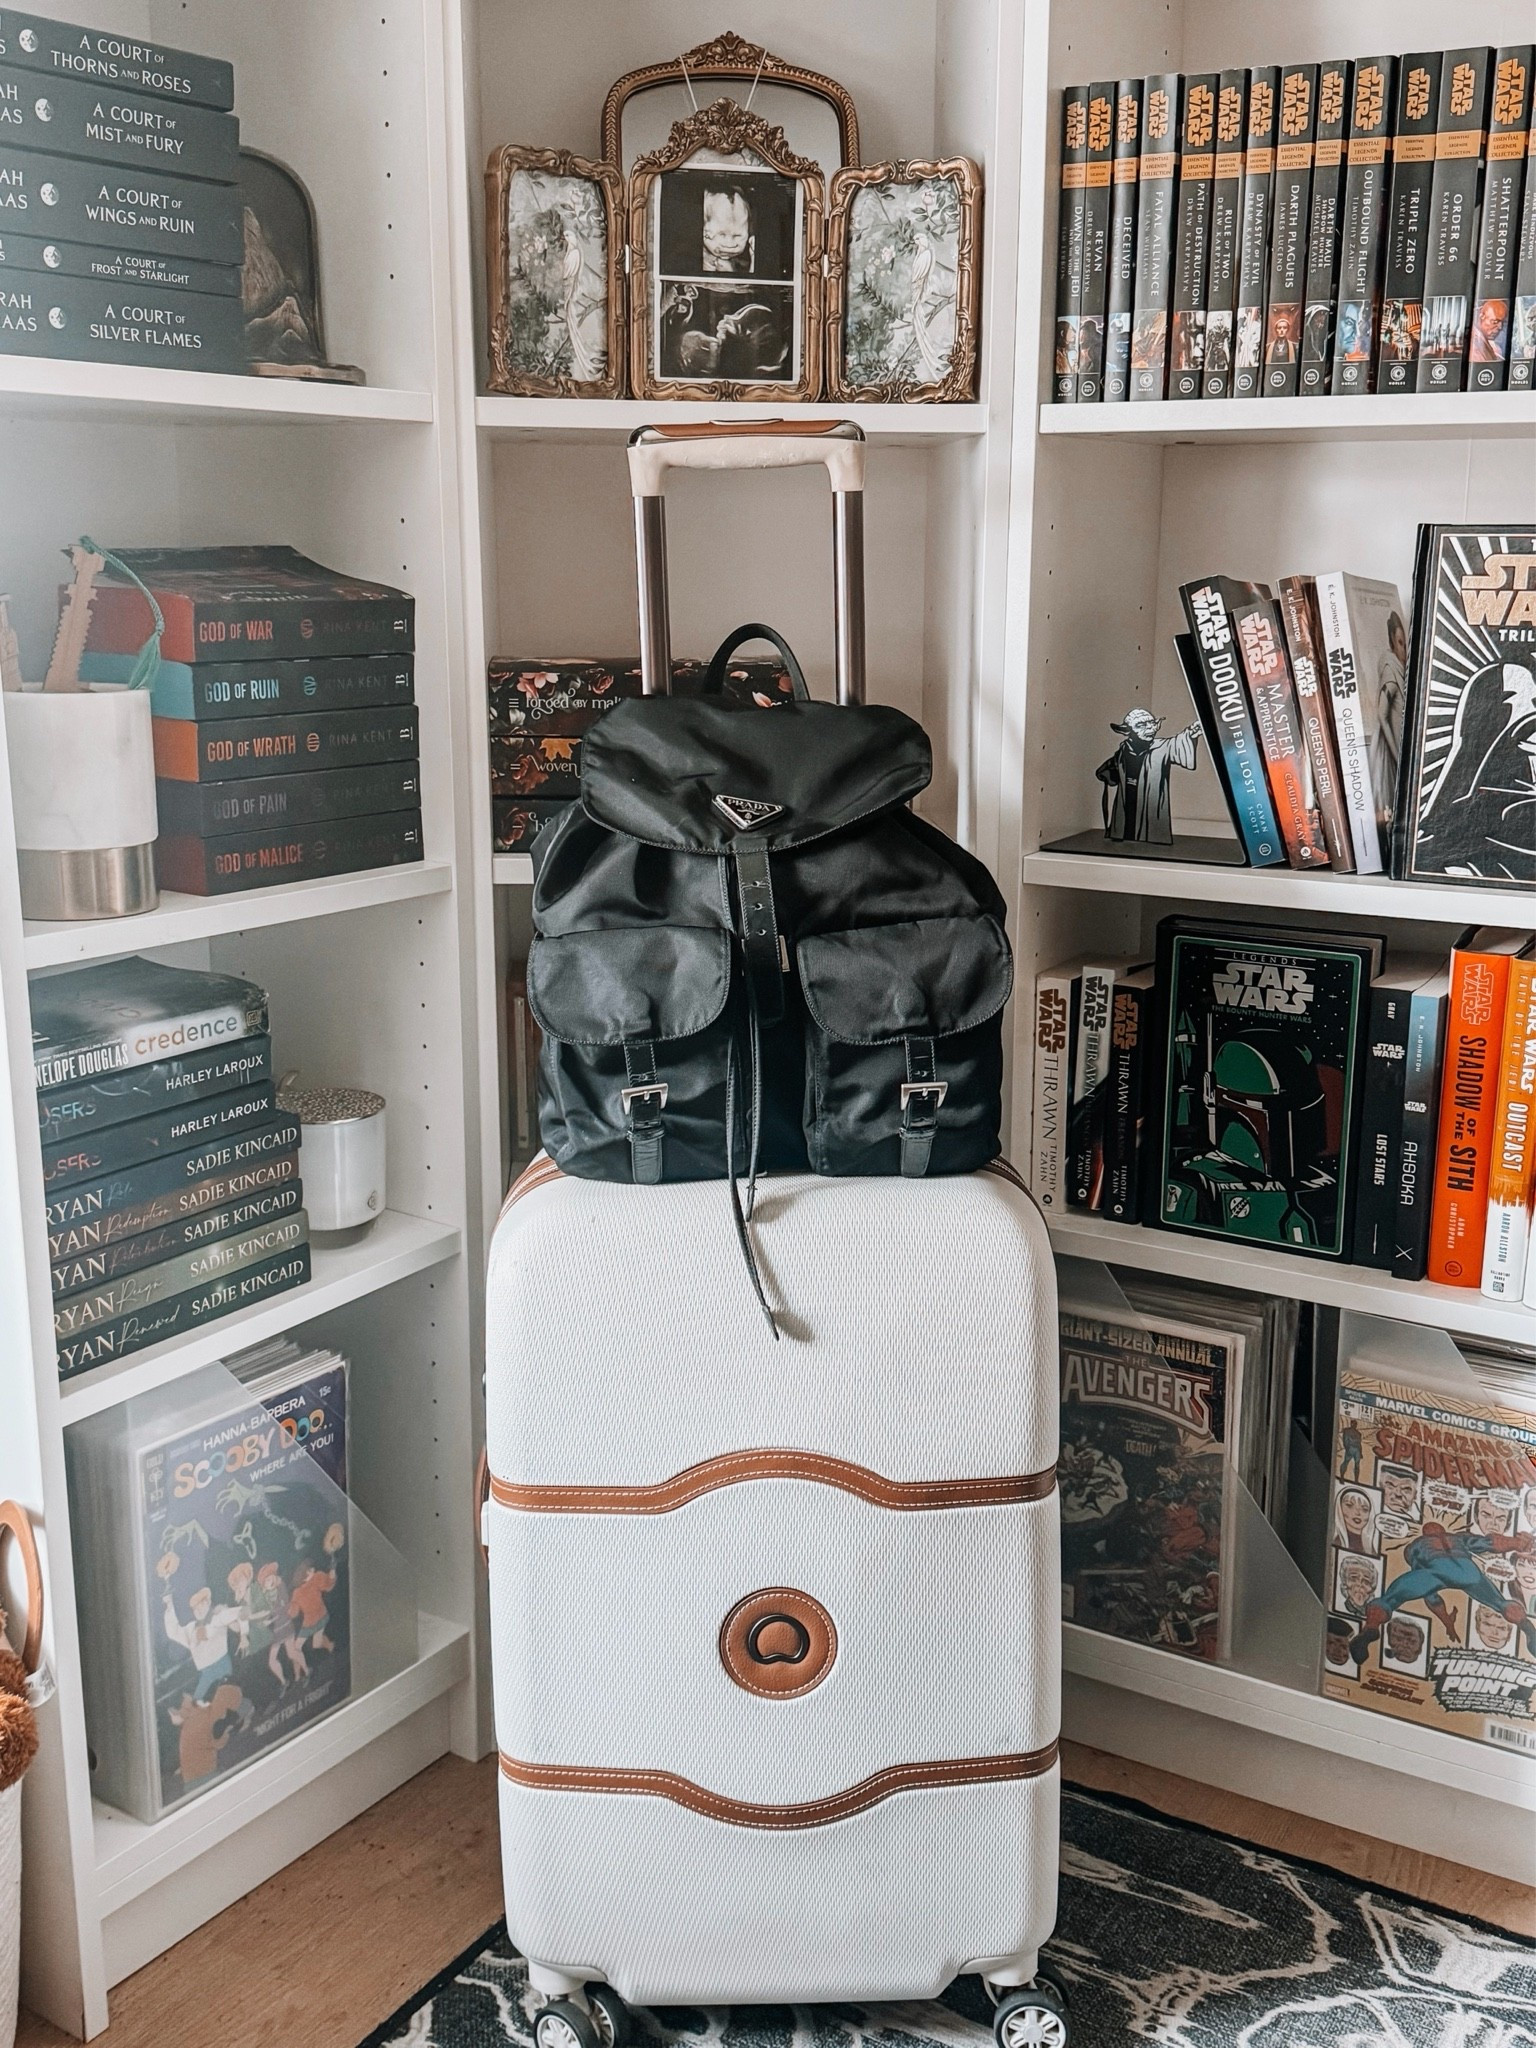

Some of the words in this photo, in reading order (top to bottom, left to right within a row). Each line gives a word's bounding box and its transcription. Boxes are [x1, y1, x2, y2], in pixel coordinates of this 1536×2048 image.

[51, 50, 119, 78] THORNS
[120, 69, 139, 80] AND
[141, 70, 192, 94] ROSES
[93, 102, 105, 118] A
[110, 105, 164, 129] COURT
[165, 119, 177, 129] OF
[1076, 101, 1086, 149] STAR
[1128, 95, 1138, 143] STAR
[86, 122, 124, 144] MIST
[125, 133, 144, 145] AND
[145, 134, 184, 154] FURY
[98, 185, 110, 201] A
[116, 188, 170, 210] COURT
[171, 199, 183, 209] OF
[1154, 192, 1164, 228] FATAL
[1197, 183, 1205, 211] PATH
[1289, 185, 1299, 226] DARTH
[1313, 195, 1321, 235] MICHAEL
[1326, 198, 1335, 234] DARTH
[1360, 170, 1373, 245] OUTBOUND
[1398, 195, 1406, 225] KAREN
[1408, 188, 1420, 232] TRIPLE
[1450, 193, 1463, 240] ORDER
[1488, 181, 1498, 233] MATTHEW
[85, 204, 137, 226] WINGS
[138, 216, 157, 227] AND
[159, 216, 195, 234] RUIN
[1197, 215, 1203, 223] OF
[1224, 210, 1232, 236] RULE
[1254, 194, 1264, 245] DYNASTY
[1494, 177, 1512, 281] SHATTERPOINT
[1094, 230, 1104, 272] REVAN
[1121, 217, 1132, 279] DECEIVED
[1183, 233, 1192, 292] KARPYSHYN
[1213, 232, 1222, 292] KARPYSHYN
[1224, 241, 1230, 249] OF
[1254, 250, 1260, 258] OF
[1276, 235, 1285, 272] LUCENO
[1285, 231, 1297, 288] PLAGUEIS
[1310, 241, 1318, 274] REAVES
[1324, 239, 1332, 268] MAUL
[1395, 231, 1404, 268] TRAVISS
[1405, 239, 1416, 273] ZERO
[1438, 228, 1447, 266] TRAVISS
[1448, 246, 1458, 262] 66
[1484, 239, 1493, 280] STOVER
[91, 263, 122, 276] FROST
[124, 269, 138, 277] AND
[139, 270, 190, 285] STARLIGHT
[1151, 235, 1161, 296] ALLIANCE
[1192, 227, 1203, 305] DESTRUCTION
[1222, 253, 1231, 279] TWO
[1251, 262, 1260, 286] EVIL
[1356, 250, 1367, 294] FLIGHT
[104, 304, 116, 319] A
[121, 306, 174, 325] COURT
[174, 315, 187, 324] OF
[89, 323, 141, 343] SILVER
[145, 329, 202, 349] FLAMES
[200, 622, 226, 643] GOD
[230, 625, 242, 639] OF
[246, 621, 273, 641] WAR
[1191, 588, 1218, 652] WARS
[1205, 586, 1231, 650] STAR
[1240, 613, 1266, 677] WARS
[1253, 611, 1278, 675] STAR
[205, 682, 231, 703] GOD
[234, 683, 247, 699] OF
[250, 679, 279, 700] RUIN
[1340, 647, 1357, 698] STAR
[1209, 652, 1245, 723] DOOKU
[1229, 725, 1247, 755] JEDI
[1240, 761, 1256, 794] LOST
[1267, 683, 1296, 759] MASTER
[1342, 708, 1358, 757] QUEEN'S
[207, 741, 233, 762] GOD
[237, 741, 250, 757] OF
[253, 735, 296, 757] WRATH
[329, 733, 357, 746] RINA
[362, 729, 393, 743] KENT
[1309, 717, 1327, 766] QUEEN'S
[1318, 767, 1332, 798] PERIL
[1349, 760, 1365, 811] SHADOW
[728, 799, 770, 812] PRADA
[1285, 773, 1301, 816] CLAUDIA
[1295, 816, 1306, 841] GRAY
[1213, 962, 1315, 993] STAR
[1233, 952, 1297, 966] LEGENDS
[1083, 976, 1099, 1031] WARS
[1094, 976, 1109, 1031] STAR
[1213, 982, 1314, 1014] WARS
[1518, 976, 1528, 1003] FATE
[135, 1015, 238, 1055] credence
[1039, 989, 1054, 1053] WARS
[1052, 989, 1067, 1053] STAR
[1113, 994, 1128, 1049] WARS
[1126, 994, 1138, 1050] STAR
[1227, 1007, 1257, 1017] BOUNTY
[1259, 1010, 1287, 1020] HUNTER
[1290, 1015, 1312, 1024] WARS
[1515, 1013, 1524, 1026] OF
[78, 1043, 129, 1077] DOUGLAS
[1084, 1033, 1099, 1097] THRAWN
[1373, 1043, 1405, 1052] STAR
[1373, 1050, 1405, 1059] WARS
[1512, 1036, 1521, 1055] THE
[166, 1068, 212, 1091] HARLEY
[216, 1054, 264, 1077] LAROUX
[1118, 1054, 1130, 1114] THRAWN
[1454, 1036, 1487, 1112] SHADOW
[1508, 1065, 1518, 1091] JEDI
[1043, 1056, 1058, 1140] THRAWN
[171, 1115, 217, 1138] HARLEY
[221, 1098, 269, 1122] LAROUX
[1454, 1112, 1465, 1140] THE
[1467, 1118, 1477, 1137] OF
[1502, 1101, 1528, 1172] OUTCAST
[1376, 1133, 1388, 1156] LOST
[1040, 1152, 1048, 1181] ZAHN
[1049, 1145, 1057, 1192] TIMOTHY
[1084, 1150, 1092, 1187] TIMOTHY
[1374, 1158, 1386, 1186] STARS
[1400, 1141, 1418, 1206] AHSOKA
[1447, 1145, 1477, 1192] SITH
[103, 1203, 169, 1244] Redemption
[179, 1183, 224, 1211] SADIE
[229, 1161, 292, 1194] KINCAID
[1457, 1218, 1465, 1236] ADAM
[1155, 1333, 1216, 1367] ANNUAL
[1062, 1354, 1212, 1437] AVENGERS
[203, 1396, 306, 1452] HANNA-BARBERA
[1376, 1397, 1430, 1419] MARVEL
[1431, 1410, 1486, 1431] COMICS
[1490, 1424, 1536, 1446] GROUP
[1407, 1421, 1513, 1458] AMAZING
[174, 1427, 275, 1498] SCOOBY
[250, 1455, 286, 1482] WHERE
[289, 1447, 308, 1462] ARE
[1433, 1659, 1536, 1688] TURNING
[1441, 1676, 1519, 1697] POINT
